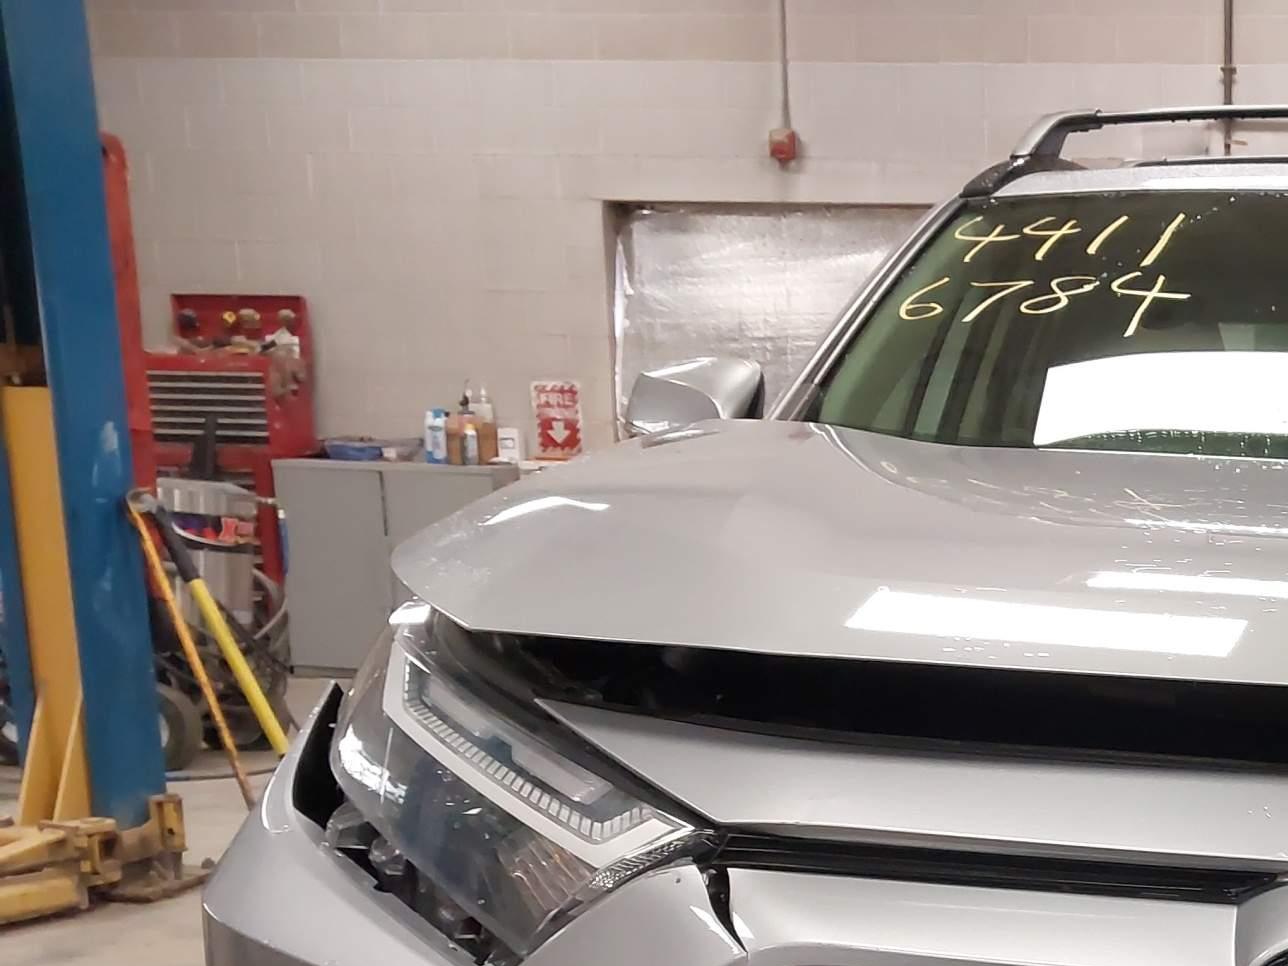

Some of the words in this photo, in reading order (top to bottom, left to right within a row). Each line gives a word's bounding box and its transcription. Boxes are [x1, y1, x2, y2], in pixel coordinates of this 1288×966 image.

[955, 212, 1186, 268] 4411
[899, 270, 1192, 338] 6784
[540, 393, 577, 407] FIRE
